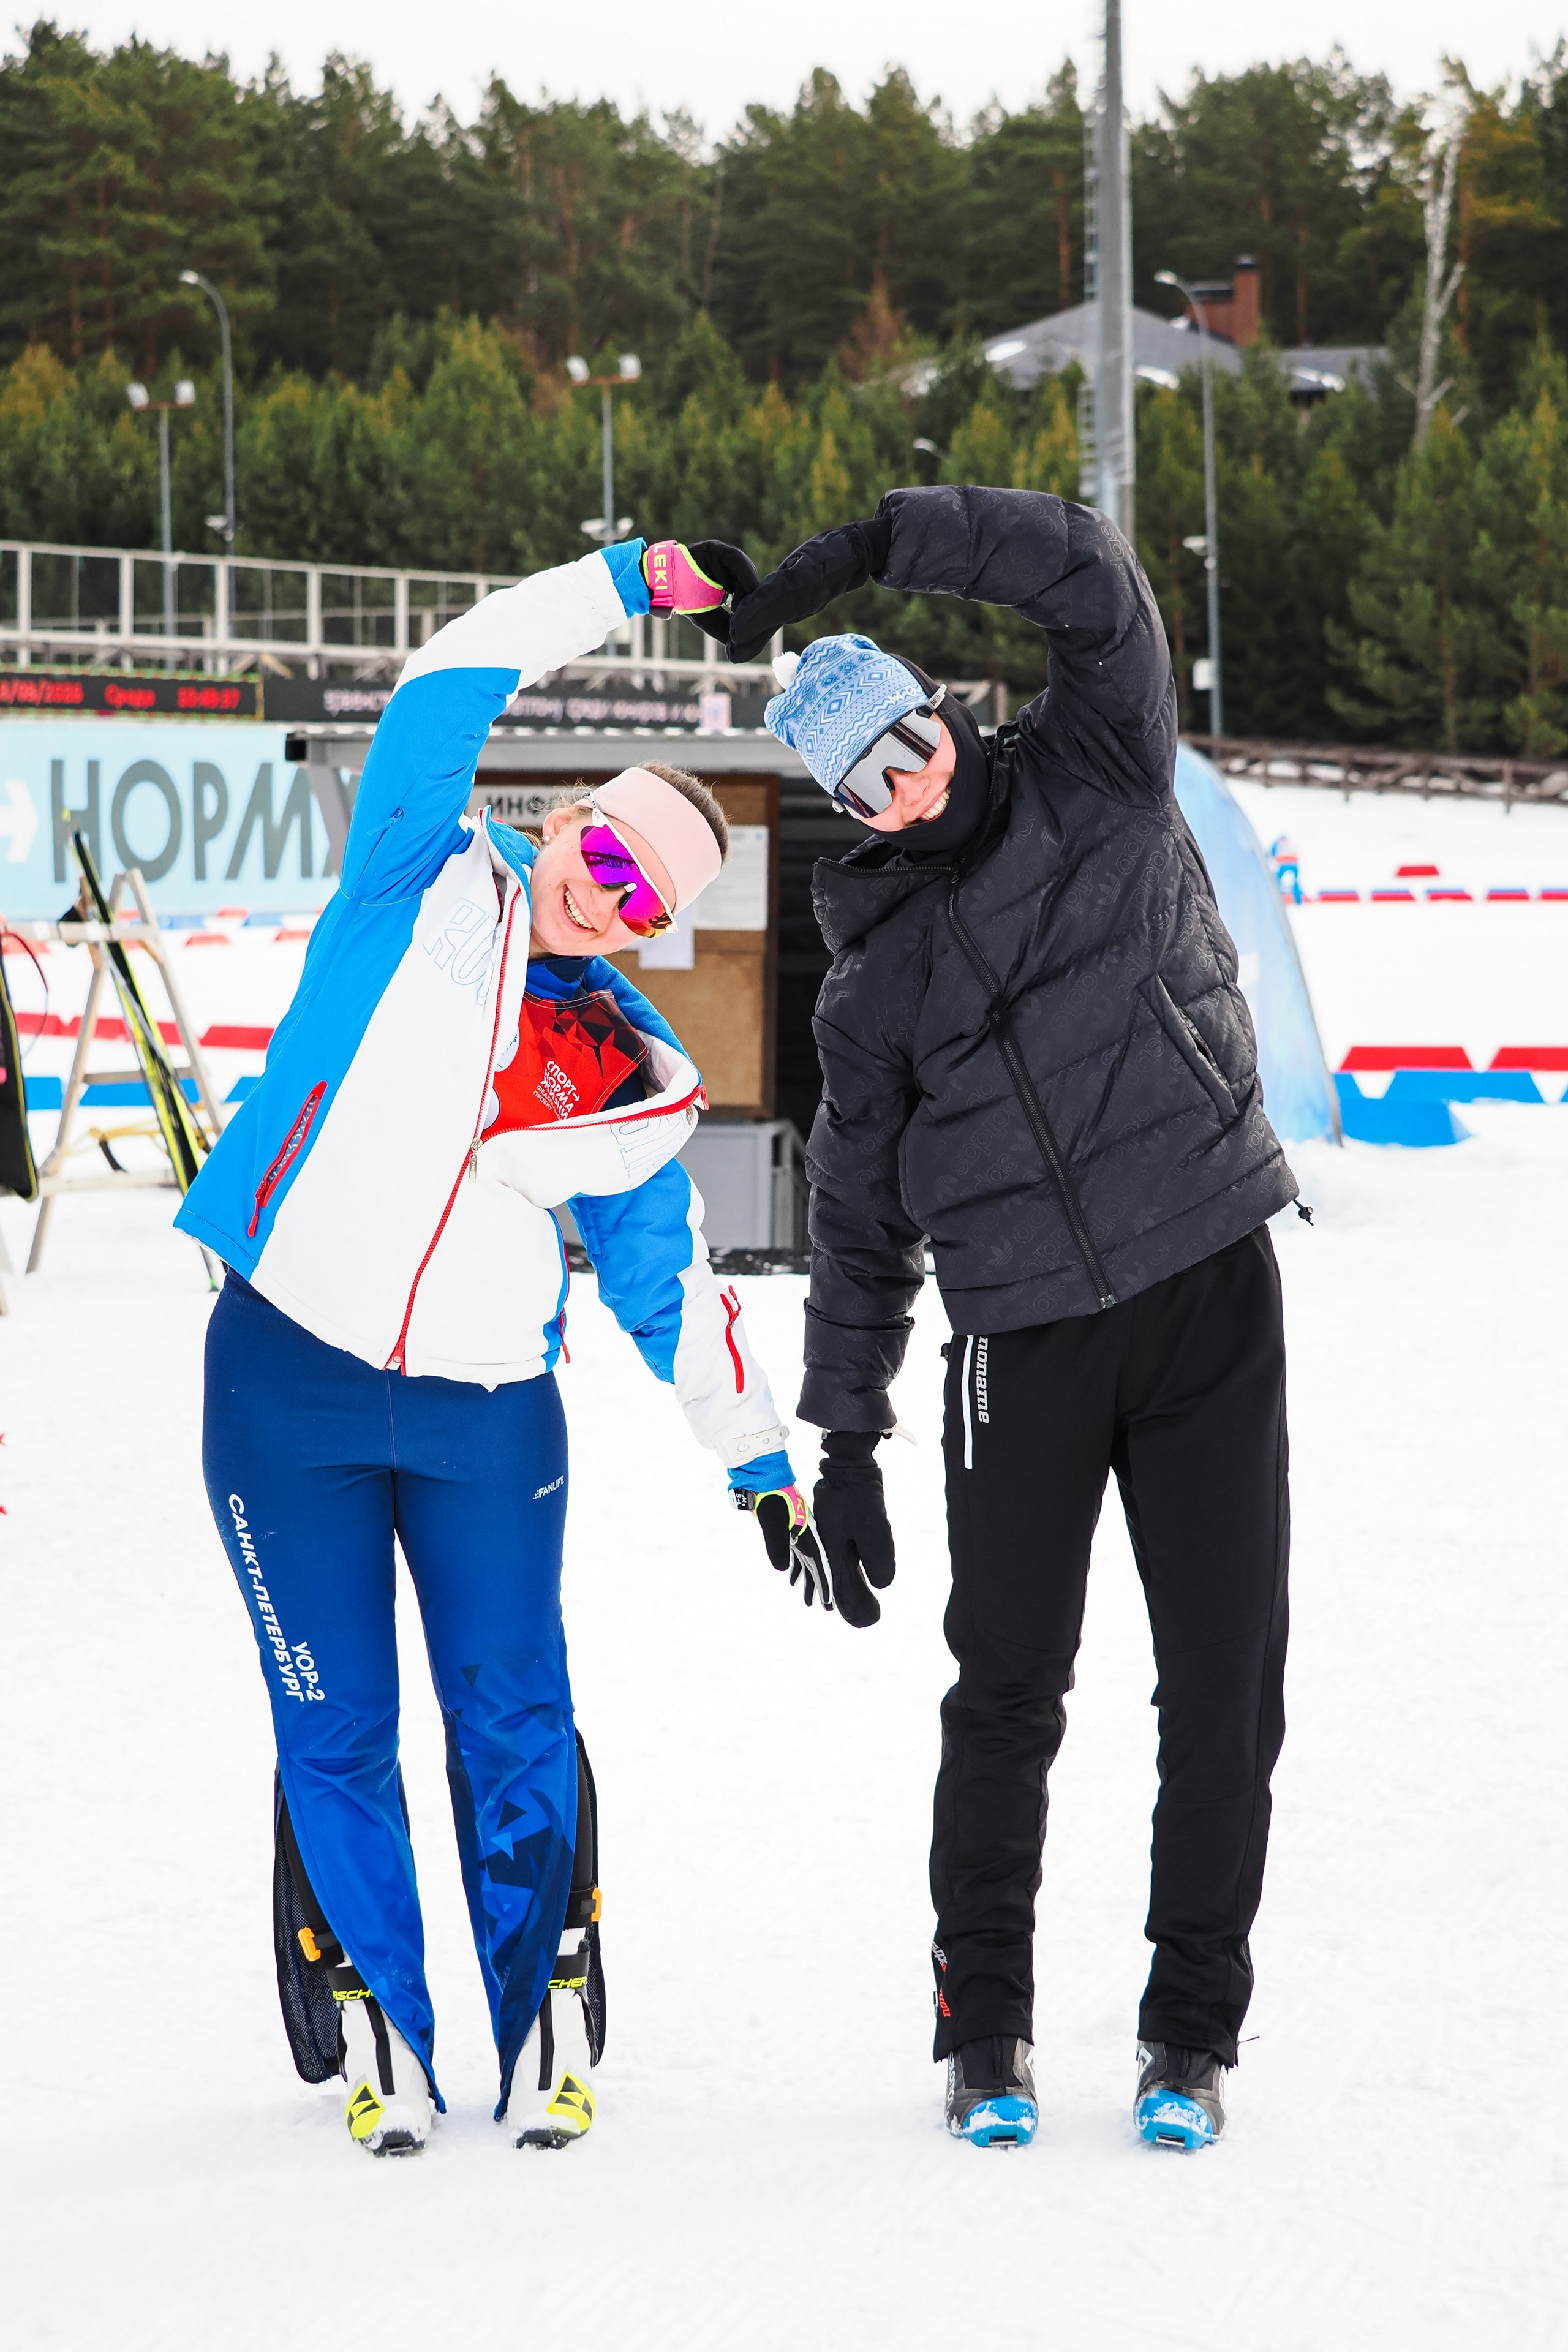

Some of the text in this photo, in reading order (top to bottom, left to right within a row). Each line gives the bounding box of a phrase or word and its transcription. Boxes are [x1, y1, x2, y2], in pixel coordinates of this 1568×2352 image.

[653, 543, 668, 590] LEKI
[532, 1090, 552, 1110] ПРОЕКТ
[544, 1068, 575, 1113] НОРМА
[546, 1060, 578, 1096] СПОРТ
[976, 1335, 990, 1424] noname
[538, 1475, 565, 1498] FANLIFE
[228, 1493, 304, 1702] САНКТ-ПЕТЕРБУРГ
[290, 1641, 325, 1702] УОР-2
[332, 1988, 374, 2002] FISCH
